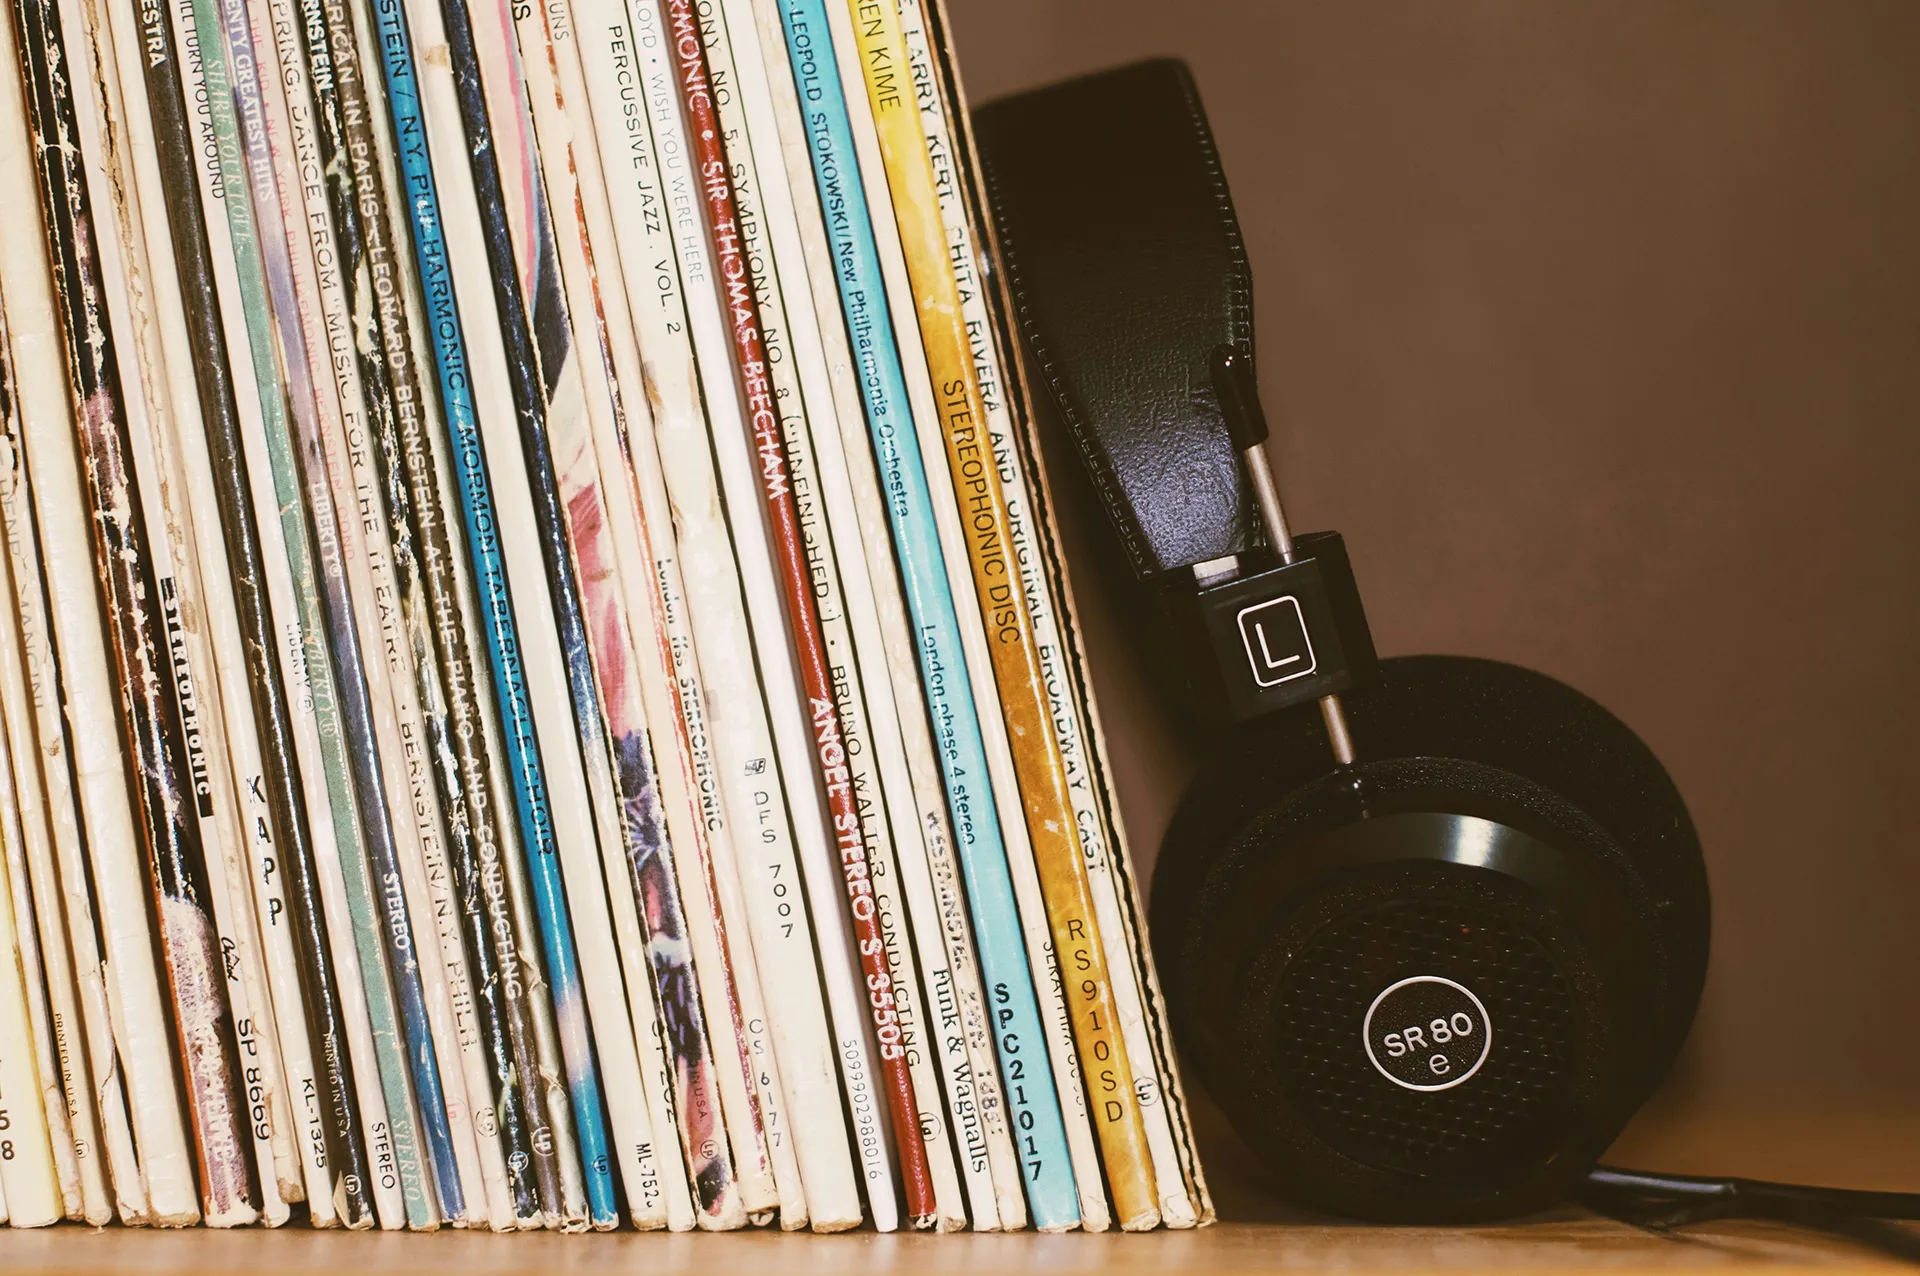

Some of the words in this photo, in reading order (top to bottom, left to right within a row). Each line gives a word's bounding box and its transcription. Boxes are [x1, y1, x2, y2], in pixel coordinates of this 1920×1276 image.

[141, 0, 167, 68] ESTRA
[184, 29, 202, 73] TURN
[380, 0, 408, 78] STEIN
[789, 10, 822, 102] LEOPOLD
[194, 80, 209, 115] YOU
[207, 59, 232, 127] SHARE
[256, 62, 270, 90] KID
[343, 100, 363, 125] IN
[650, 73, 671, 121] WISH
[200, 122, 225, 199] AROUND
[216, 131, 241, 190] YOUR
[235, 55, 269, 157] GREATEST
[254, 160, 276, 200] HITS
[400, 116, 423, 163] N.Y.
[660, 128, 682, 170] YOU
[608, 25, 649, 170] PERCUSSIVE
[636, 180, 662, 236] JAZZ
[653, 259, 675, 312] VOL.
[667, 321, 682, 336] 2
[671, 174, 694, 230] WERE
[701, 160, 727, 202] SIR
[410, 175, 466, 391] PHILHARMONIC
[680, 237, 705, 284] HERE
[718, 218, 758, 343] THOMAS
[292, 106, 322, 200] DANCE
[310, 212, 337, 289] FROM
[345, 411, 365, 467] FOR
[358, 483, 379, 535] THE
[847, 291, 887, 417] Philharmonia
[869, 47, 901, 112] KIME
[944, 379, 1005, 577] STEREOPHONIC
[989, 584, 1020, 644] DISC
[397, 388, 437, 529] BERNSTEIN
[742, 359, 790, 500] BEECHAM
[903, 30, 937, 115] LARRY
[944, 227, 976, 306] CHITA
[966, 320, 1001, 412] RIVERA
[989, 431, 1016, 484] AND
[1007, 500, 1049, 630] ORIGINAL
[1038, 644, 1087, 792] BROADWAY
[1076, 809, 1105, 873] CAST
[457, 427, 497, 556] MORMON
[878, 424, 910, 517] Orchestra
[425, 545, 445, 576] AT
[697, 0, 720, 51] ONY
[732, 163, 773, 309] SYMPHONY
[775, 387, 790, 400] 8
[831, 665, 862, 756] BRUNO
[854, 771, 886, 877] WALTER
[876, 894, 921, 1067] CONDUCTING
[430, 591, 458, 645] THE
[1255, 622, 1300, 668] L
[484, 566, 535, 752] TABERNACLE
[920, 624, 948, 697] London
[163, 599, 211, 795] STEREOPHONIC
[445, 661, 475, 739] PIANO
[932, 703, 960, 760] phase
[462, 755, 488, 809] AND
[679, 677, 724, 833] STEREOPHONIC
[809, 697, 852, 797] ANGEL
[950, 766, 966, 779] 4
[522, 764, 554, 857] CHOIR
[952, 785, 976, 845] stereo
[246, 775, 283, 926] KAPP
[835, 813, 876, 921] STEREO
[383, 872, 410, 951] STEREO
[477, 824, 523, 1001] CONDUCTING
[769, 863, 795, 939] 7007
[221, 937, 240, 981] Capitol
[860, 939, 882, 956] S
[866, 973, 905, 1061] 35505
[932, 969, 961, 1030] Funk
[1384, 1026, 1428, 1057] SR
[1429, 1012, 1473, 1043] 80
[54, 1013, 70, 1064] PRINTED
[64, 1071, 72, 1082] IN
[238, 1019, 257, 1057] SP
[947, 1036, 966, 1055] &
[1429, 1054, 1450, 1075] e
[246, 1068, 270, 1140] 8669
[303, 1078, 327, 1168] KL-1325
[331, 1089, 342, 1102] IN
[843, 1040, 882, 1180] 5099902988016
[951, 1062, 989, 1173] Wagnalls
[371, 1122, 395, 1189] STEREO
[392, 1118, 420, 1200] STEREO
